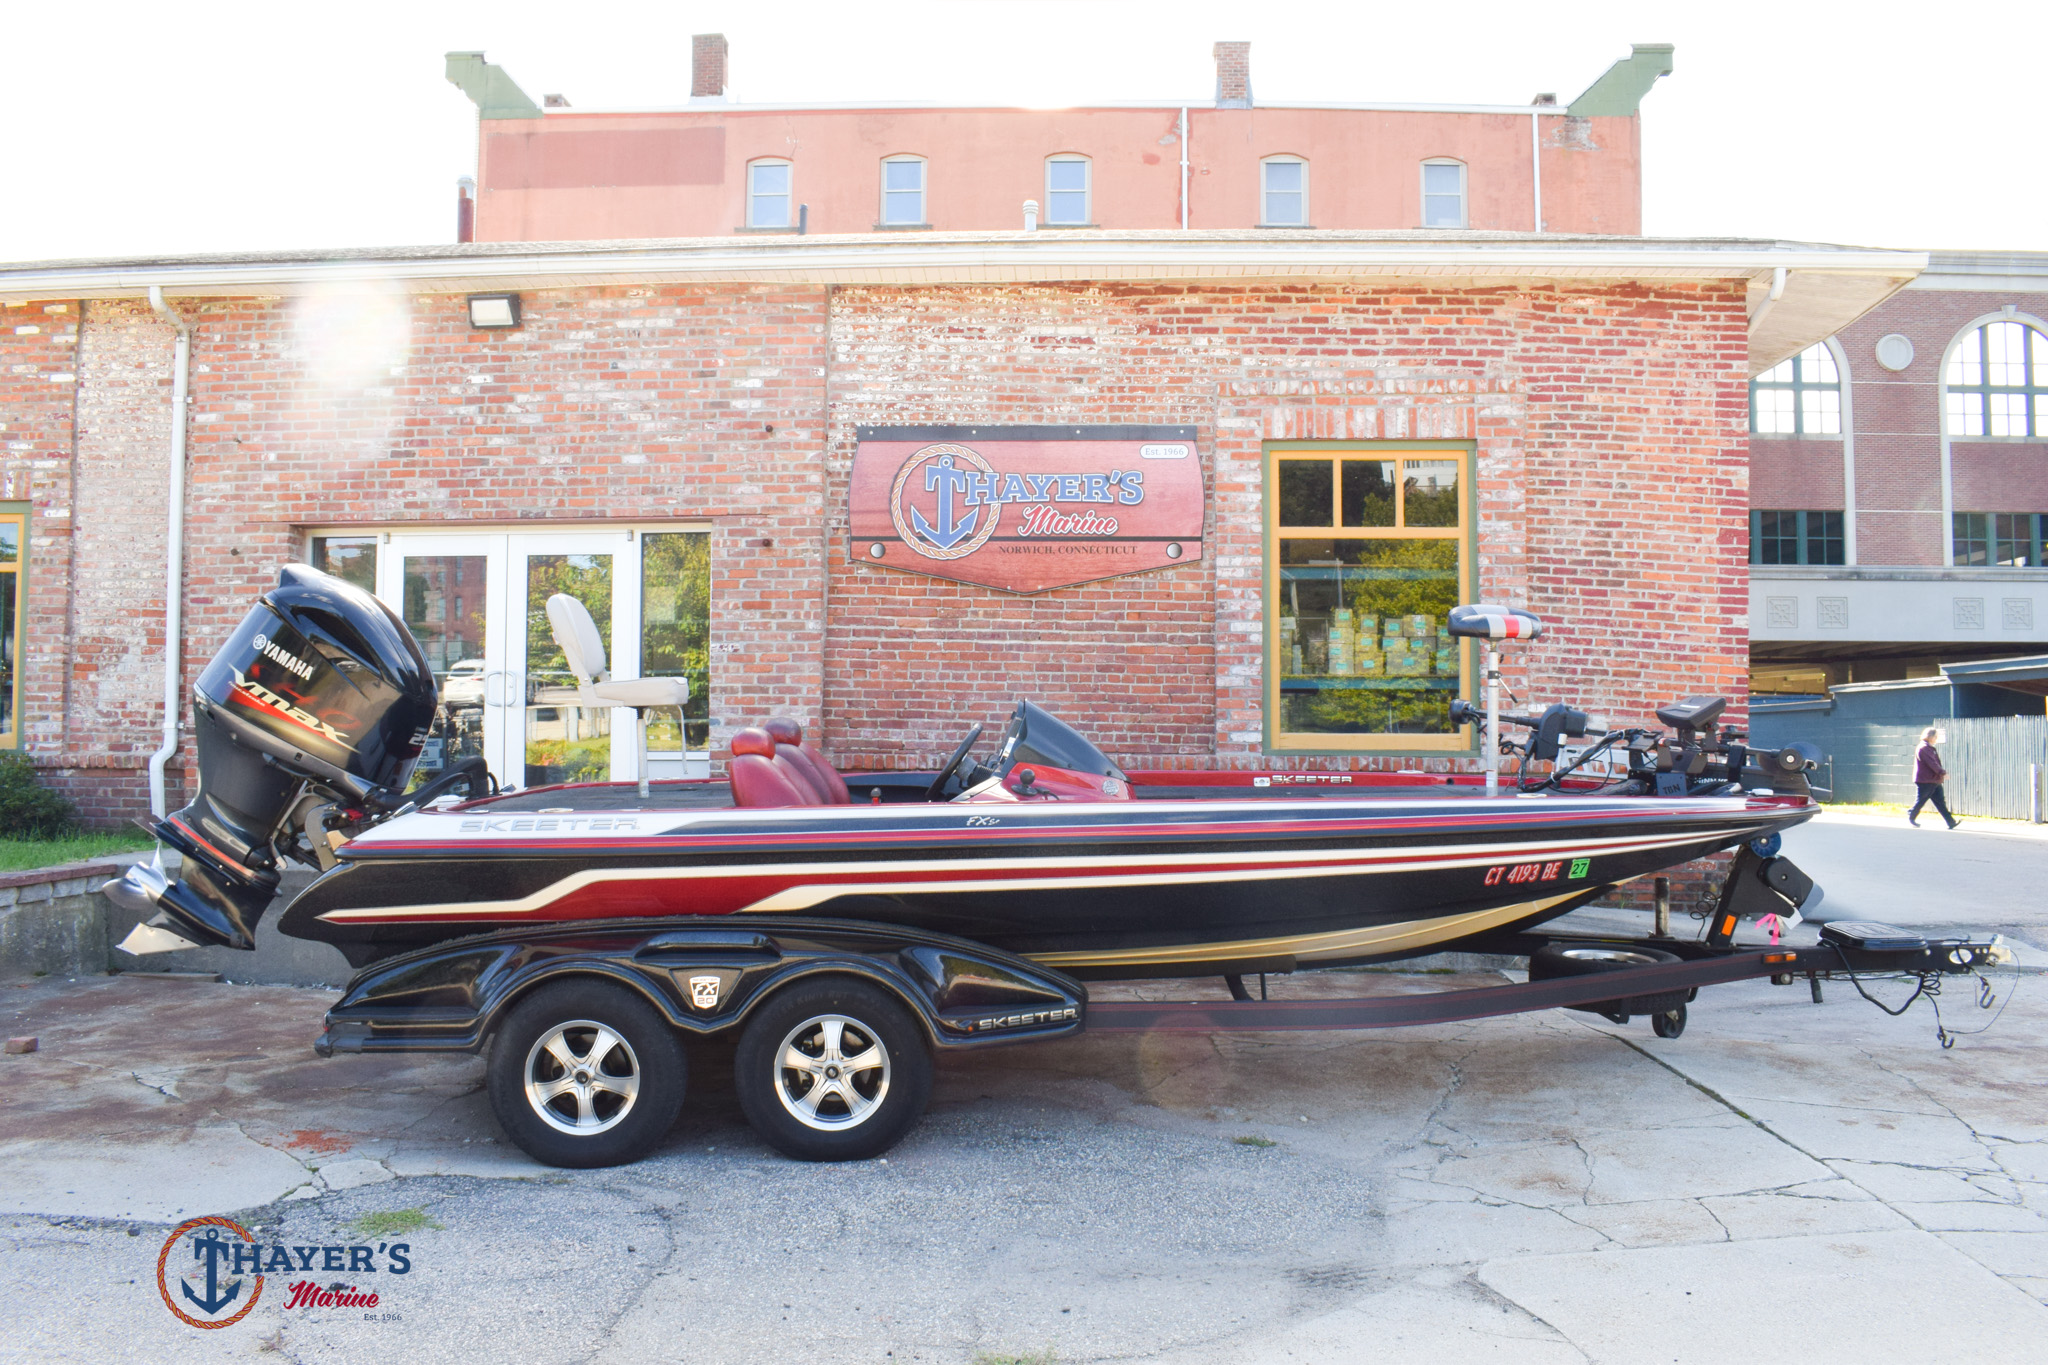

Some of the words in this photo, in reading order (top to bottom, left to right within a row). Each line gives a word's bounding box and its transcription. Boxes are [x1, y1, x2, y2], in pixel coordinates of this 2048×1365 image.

[1145, 447, 1161, 456] Est.
[1163, 447, 1184, 456] 1966
[1017, 504, 1120, 537] Marine
[1058, 545, 1138, 555] CONNECTICUT
[263, 640, 314, 681] YAMAHA
[1272, 774, 1352, 784] SKEETER
[459, 818, 638, 832] SKEETER
[1484, 866, 1507, 886] CT
[1506, 863, 1541, 884] 4193
[1541, 861, 1563, 881] BE
[1572, 862, 1588, 875] 27
[697, 997, 714, 1005] 20
[979, 1008, 1076, 1030] SKEETER
